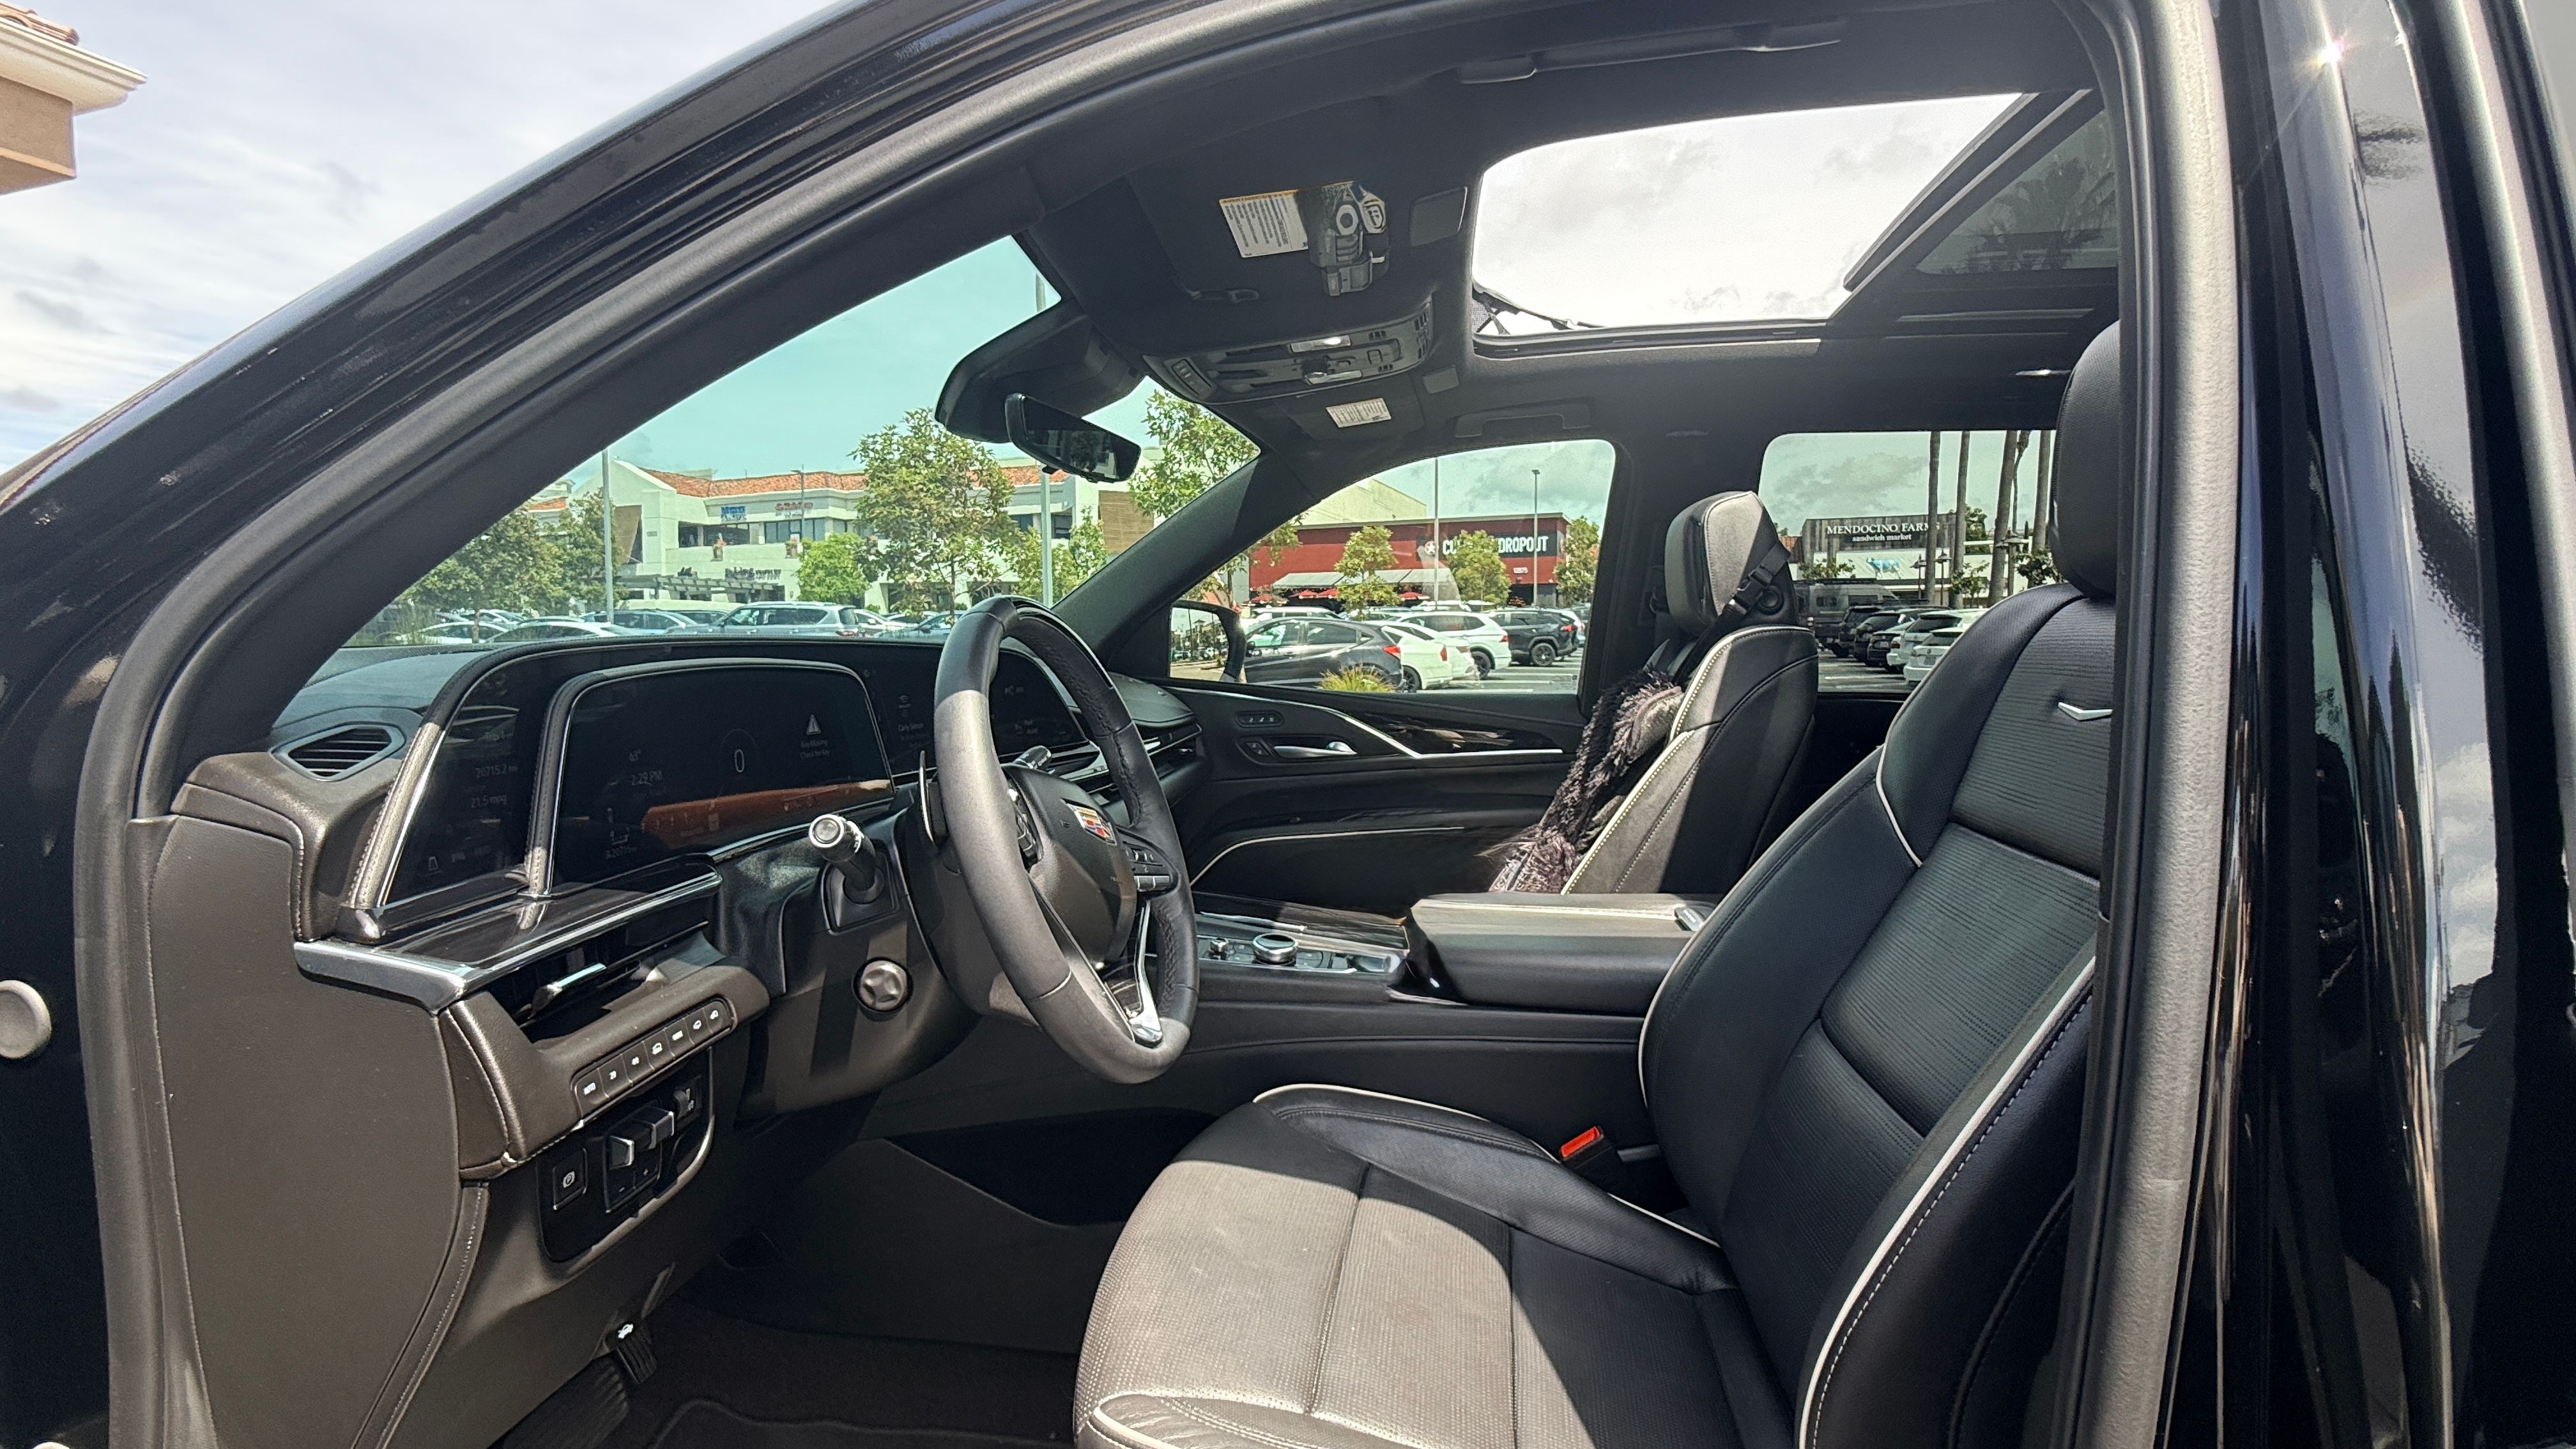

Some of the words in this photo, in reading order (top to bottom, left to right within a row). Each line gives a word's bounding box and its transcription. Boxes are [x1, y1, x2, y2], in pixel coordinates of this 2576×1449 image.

[1827, 523, 1898, 534] MENDOCINO
[1498, 535, 1549, 553] DROPOUT
[1852, 533, 1885, 542] sandwich
[1886, 533, 1912, 541] market
[734, 749, 745, 773] 0
